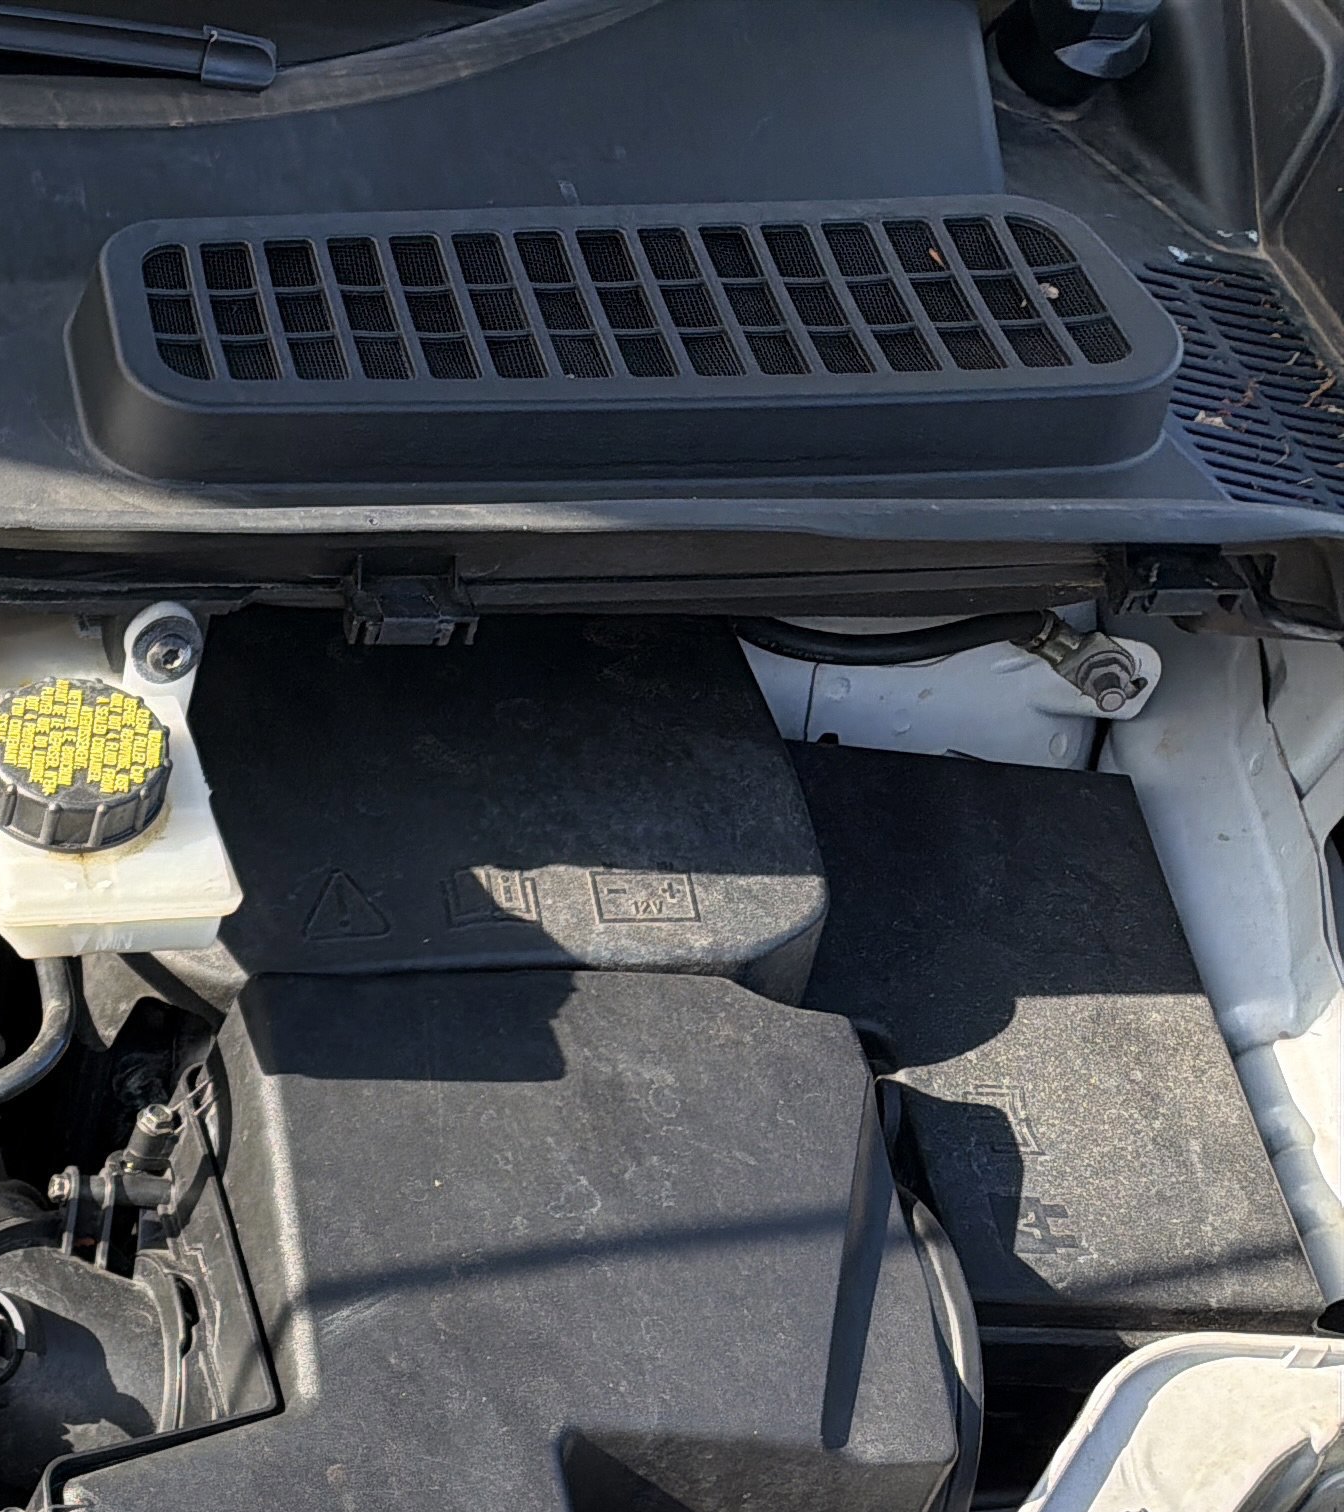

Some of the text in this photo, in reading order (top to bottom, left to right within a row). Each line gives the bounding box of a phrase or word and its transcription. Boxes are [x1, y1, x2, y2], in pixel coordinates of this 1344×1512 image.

[55, 680, 69, 702] AVANT
[25, 696, 39, 711] DOT
[53, 705, 67, 716] DE
[122, 698, 137, 727] BEFORE
[36, 717, 50, 733] QUE
[51, 718, 65, 728] LE
[93, 706, 108, 735] SEALED
[108, 715, 122, 731] DOT
[3, 719, 22, 765] CONTENANT
[17, 722, 36, 769] PROVENANT
[34, 735, 49, 747] DU
[64, 731, 78, 742] LE
[130, 709, 149, 783] CLEAN FILLER CAP
[104, 742, 119, 765] FLUID
[29, 750, 46, 784] LIQUIDE
[58, 746, 75, 785] BOUCHON
[100, 768, 116, 793] FROM
[114, 775, 129, 792] USE
[630, 899, 664, 917] 12V
